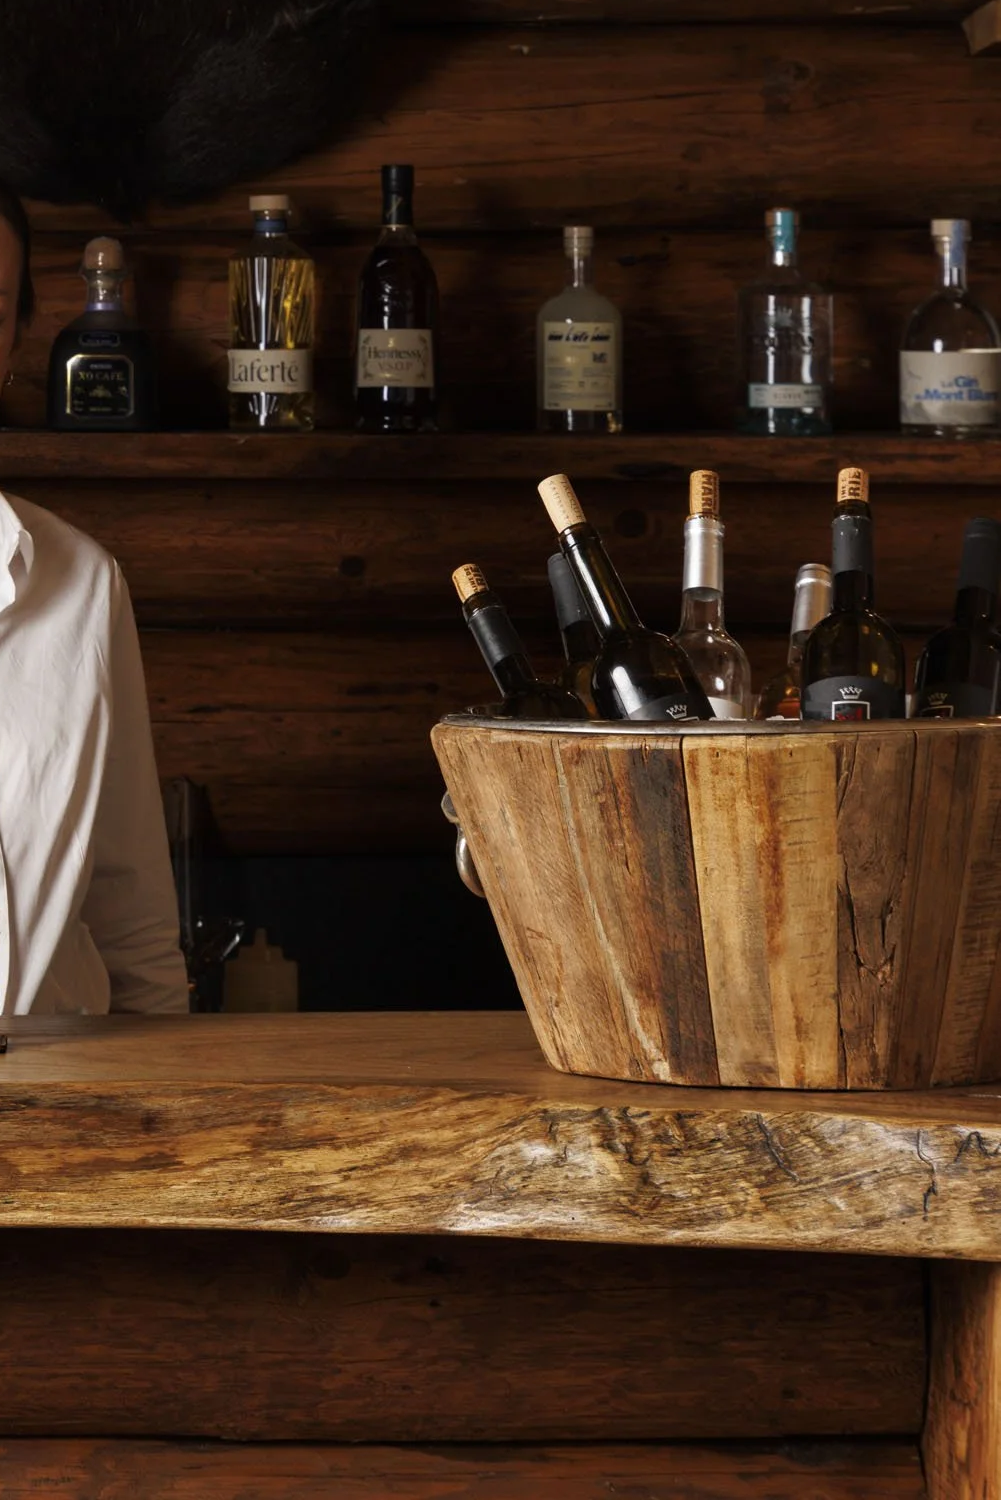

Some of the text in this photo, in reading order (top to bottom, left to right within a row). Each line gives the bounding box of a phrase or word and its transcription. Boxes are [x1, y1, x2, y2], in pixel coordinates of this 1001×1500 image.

[368, 346, 422, 362] Hennessy
[78, 370, 95, 381] XO
[230, 357, 299, 383] Laferté
[925, 388, 965, 401] Mont
